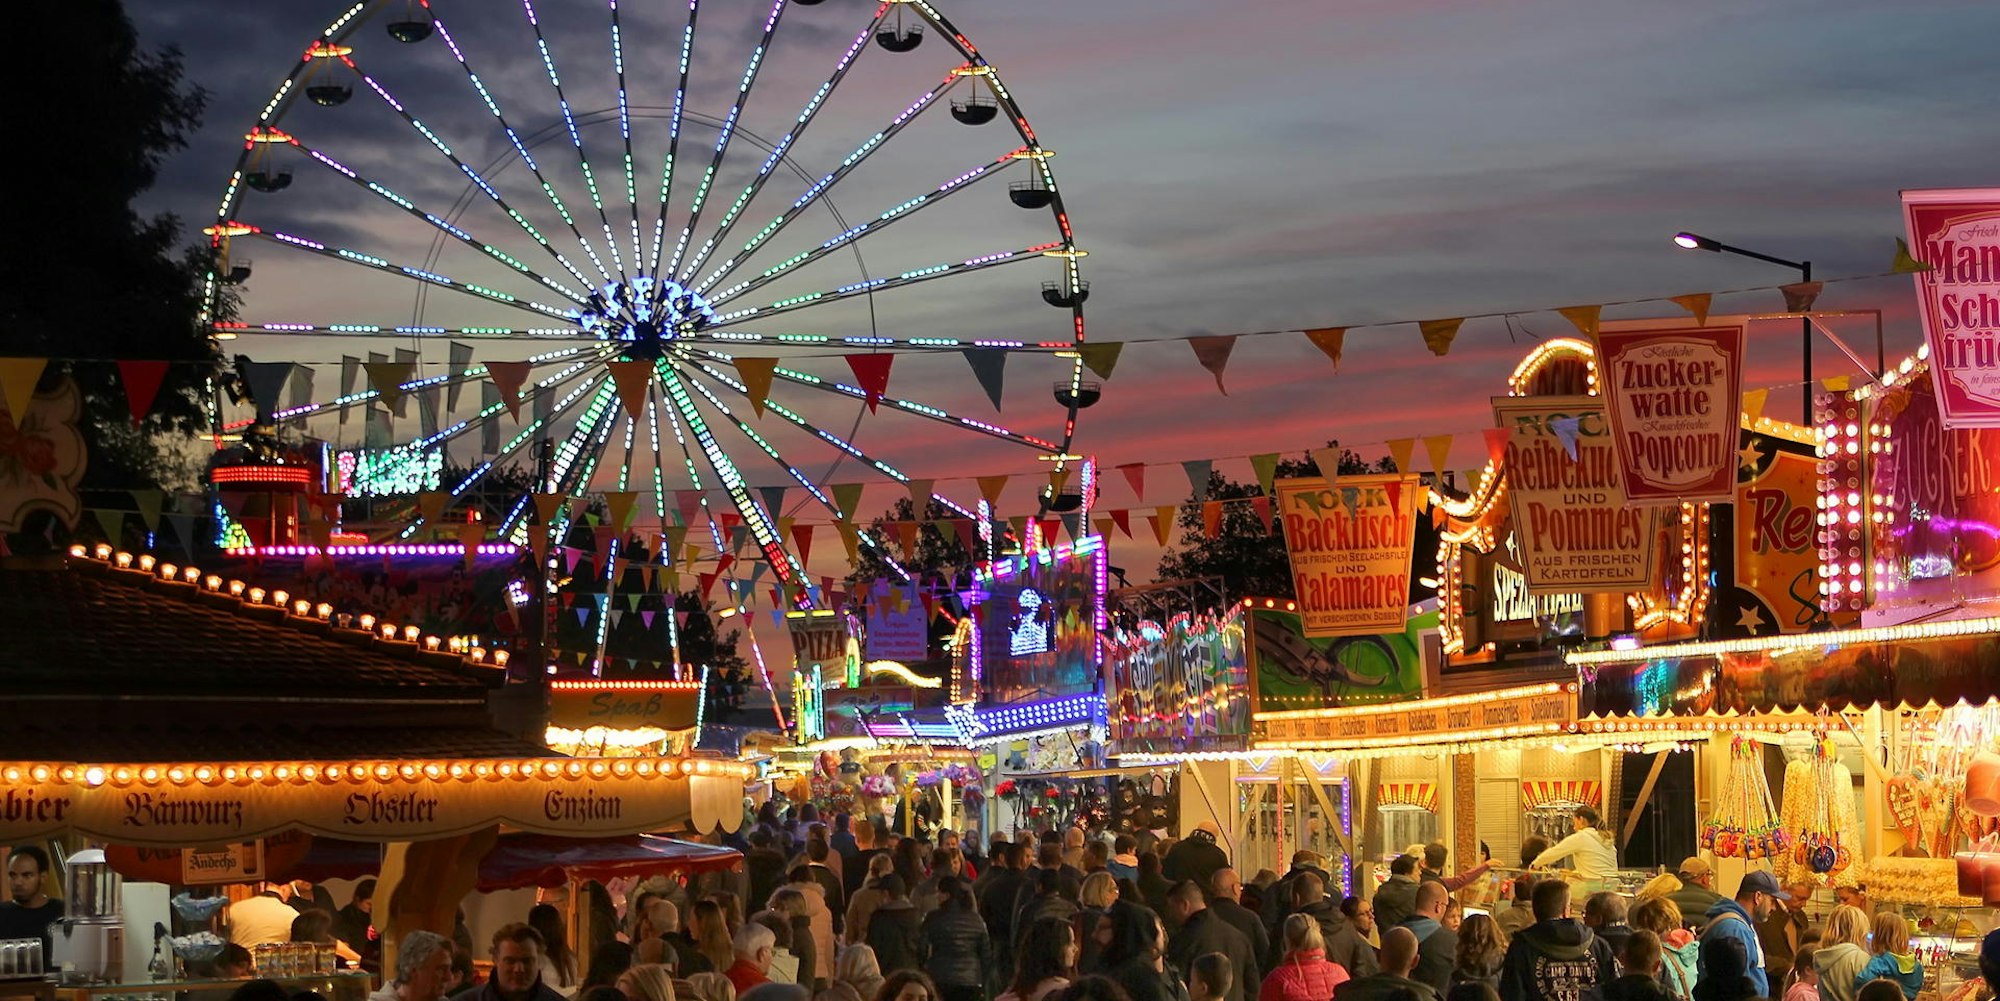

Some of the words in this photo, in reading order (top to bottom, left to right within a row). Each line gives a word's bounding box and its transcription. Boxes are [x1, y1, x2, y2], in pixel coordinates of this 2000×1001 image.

[1943, 331, 2000, 370] frü
[1621, 358, 1724, 390] Zucker-
[1630, 387, 1709, 418] watte
[1504, 439, 1619, 492] Reibekuc
[1628, 431, 1721, 479] Popcorn
[1564, 492, 1606, 505] UND
[1527, 502, 1642, 552] Pommes
[1336, 564, 1367, 575] UND
[1534, 556, 1563, 567] AUS
[1570, 553, 1642, 566] FRISCHEN
[1541, 566, 1634, 580] KARTOFFELN
[1297, 572, 1407, 613] Calamares
[791, 629, 846, 661] PIZZA
[588, 692, 663, 720] Spaß
[0, 788, 70, 823] bier
[122, 792, 244, 830] Bärwurz
[342, 790, 438, 825] Obstler
[544, 788, 621, 824] Enzian
[1545, 966, 1567, 978] CAMP
